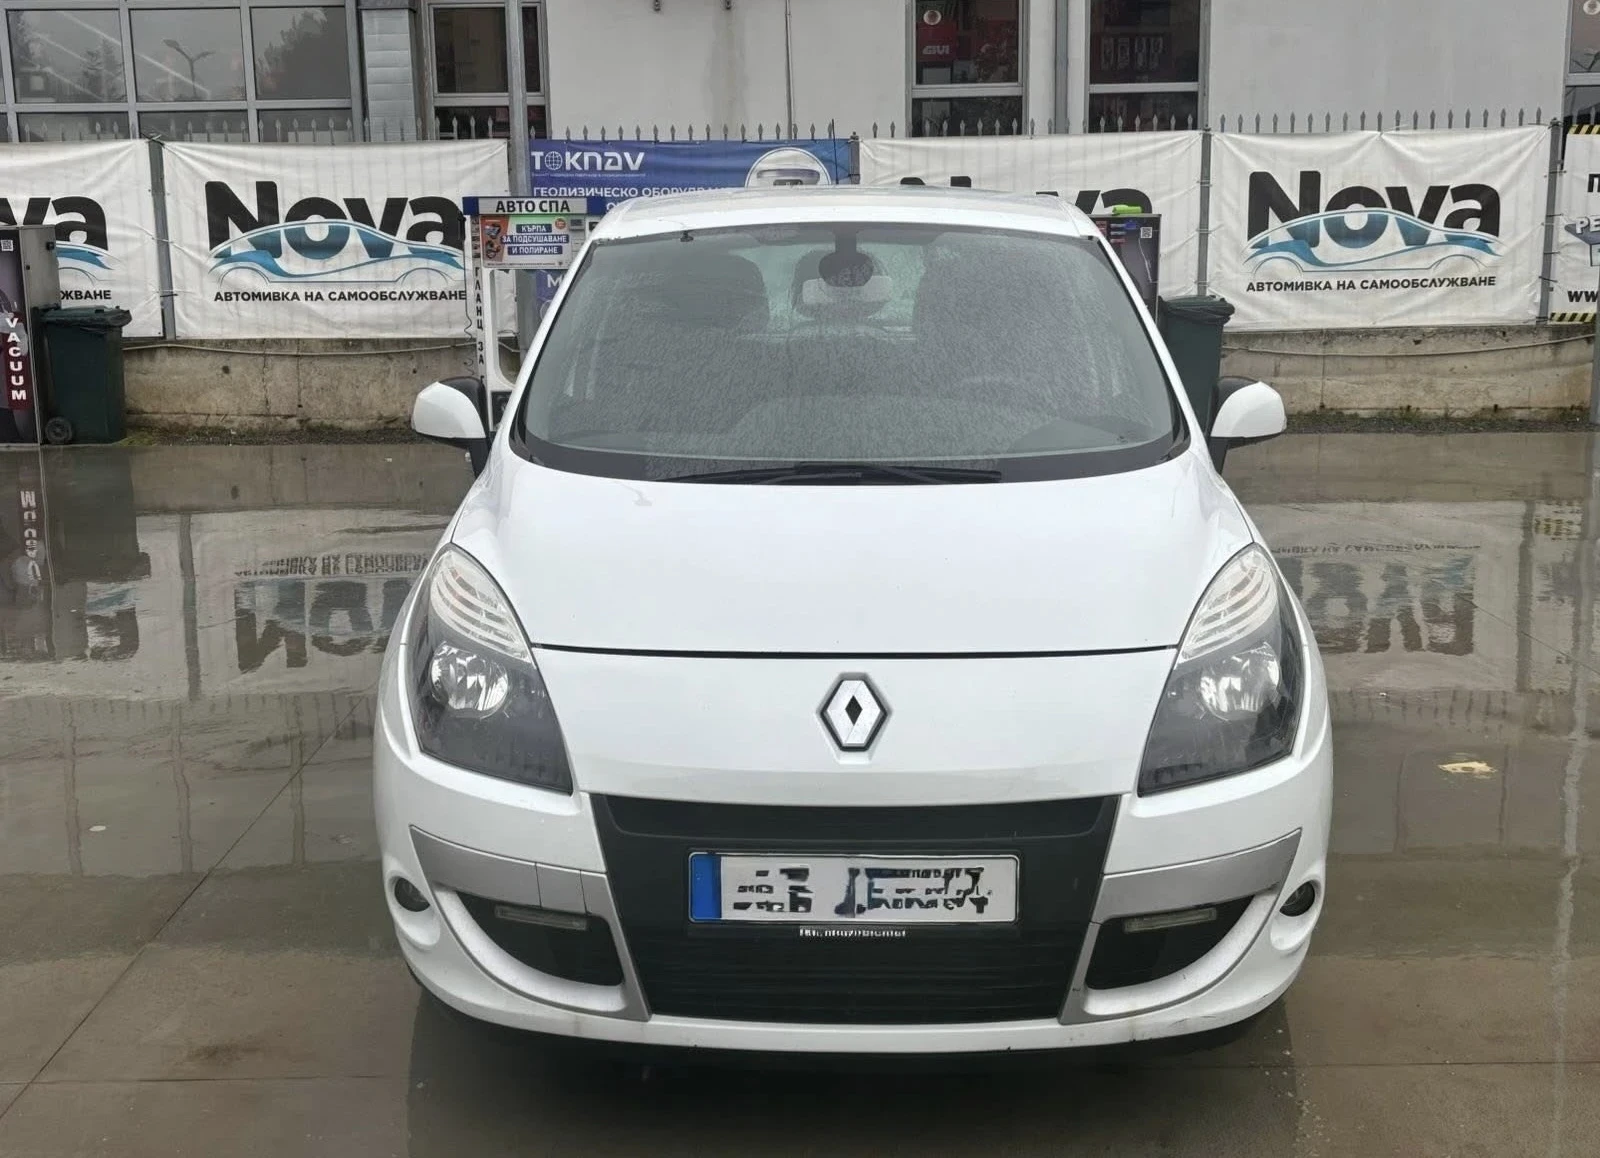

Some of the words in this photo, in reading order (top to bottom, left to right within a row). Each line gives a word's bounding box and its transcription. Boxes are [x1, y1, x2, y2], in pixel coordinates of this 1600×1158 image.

[533, 187, 638, 198] ГЕОДИЗИЧЕСКО
[495, 200, 536, 213] АВТО
[539, 200, 571, 213] СПА
[1247, 170, 1500, 249] Nova
[205, 181, 465, 260] Nova
[521, 225, 546, 233] КЪРПА
[502, 235, 512, 243] ЗА
[513, 235, 567, 243] ПОДСУШАВАНЕ
[1246, 280, 1332, 293] АВТОМИВКА
[1336, 279, 1356, 291] НА
[1360, 275, 1497, 290] САМООБСЛУЖВАНЕ
[213, 290, 301, 303] АВТОМИВКА
[304, 290, 324, 302] НА
[328, 289, 467, 302] САМООБСЛУЖВАНЕ
[5, 317, 27, 401] VACUUM
